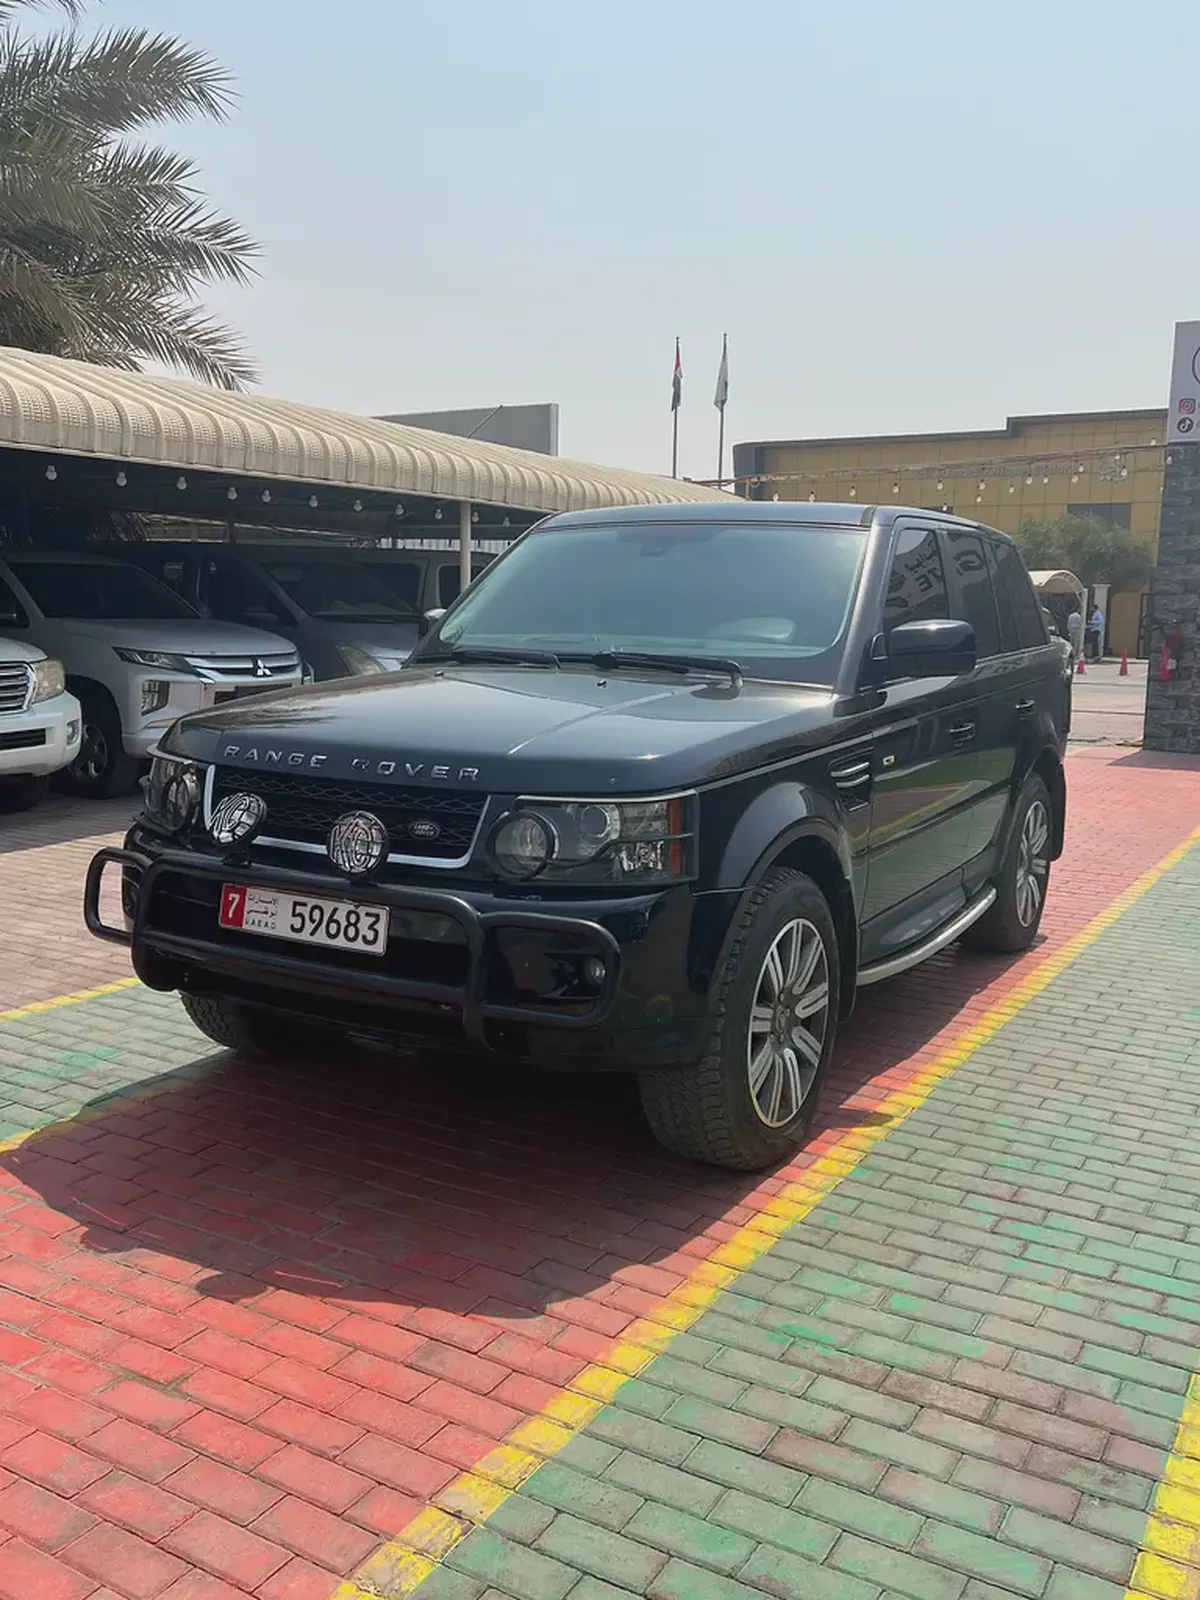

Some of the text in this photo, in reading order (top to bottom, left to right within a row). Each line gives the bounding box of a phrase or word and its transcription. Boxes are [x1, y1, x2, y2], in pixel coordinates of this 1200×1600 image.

[223, 745, 480, 781] RANGE ROVER
[228, 893, 240, 919] 7
[290, 900, 381, 946] 59683
